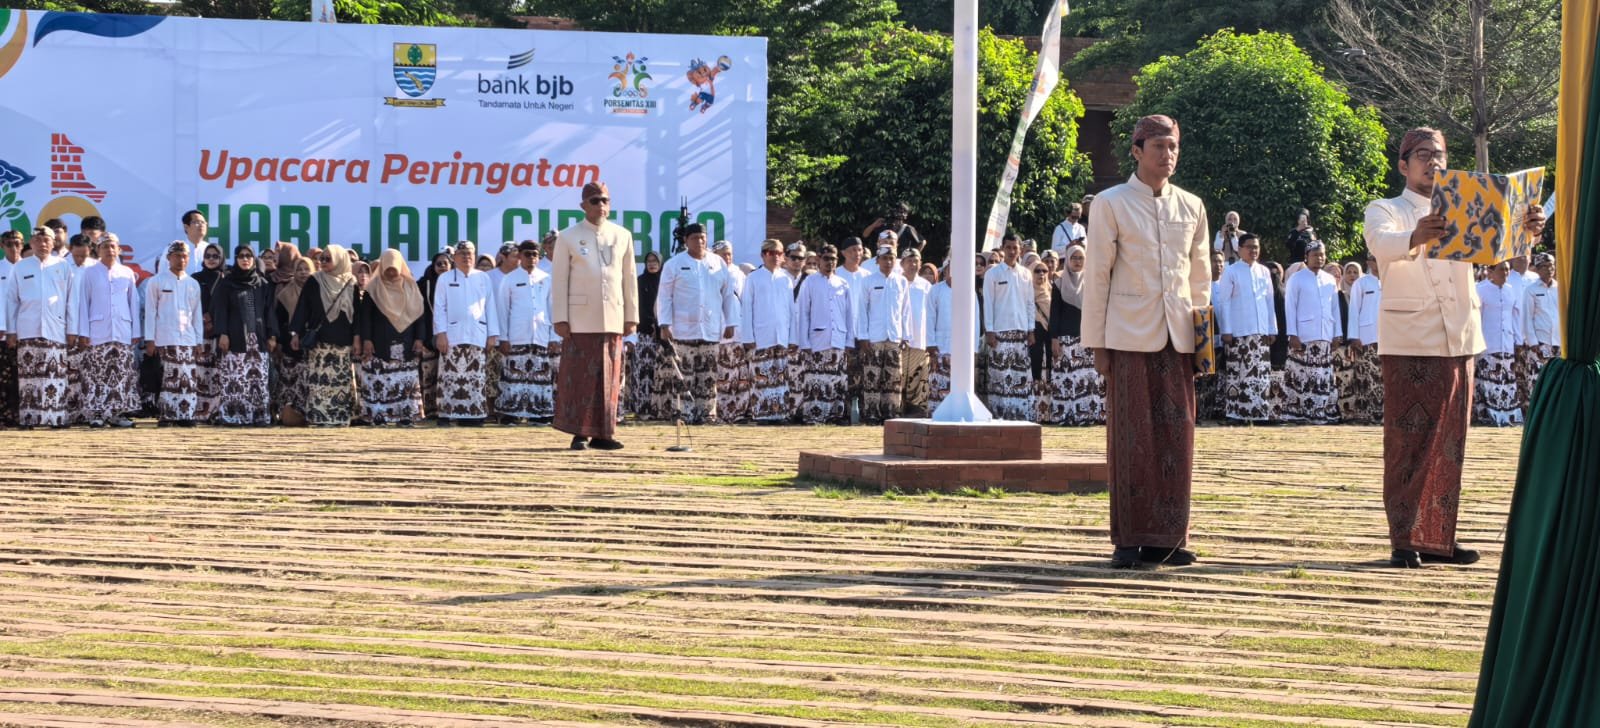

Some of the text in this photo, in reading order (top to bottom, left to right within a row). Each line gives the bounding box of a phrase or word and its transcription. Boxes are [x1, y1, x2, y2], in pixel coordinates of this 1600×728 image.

[478, 73, 574, 100] bank bjb
[479, 99, 575, 112] Tandamata Untuk Negeri
[198, 149, 601, 195] Upacara Peringatan
[196, 203, 331, 260] HARI
[351, 206, 479, 262] JADI
